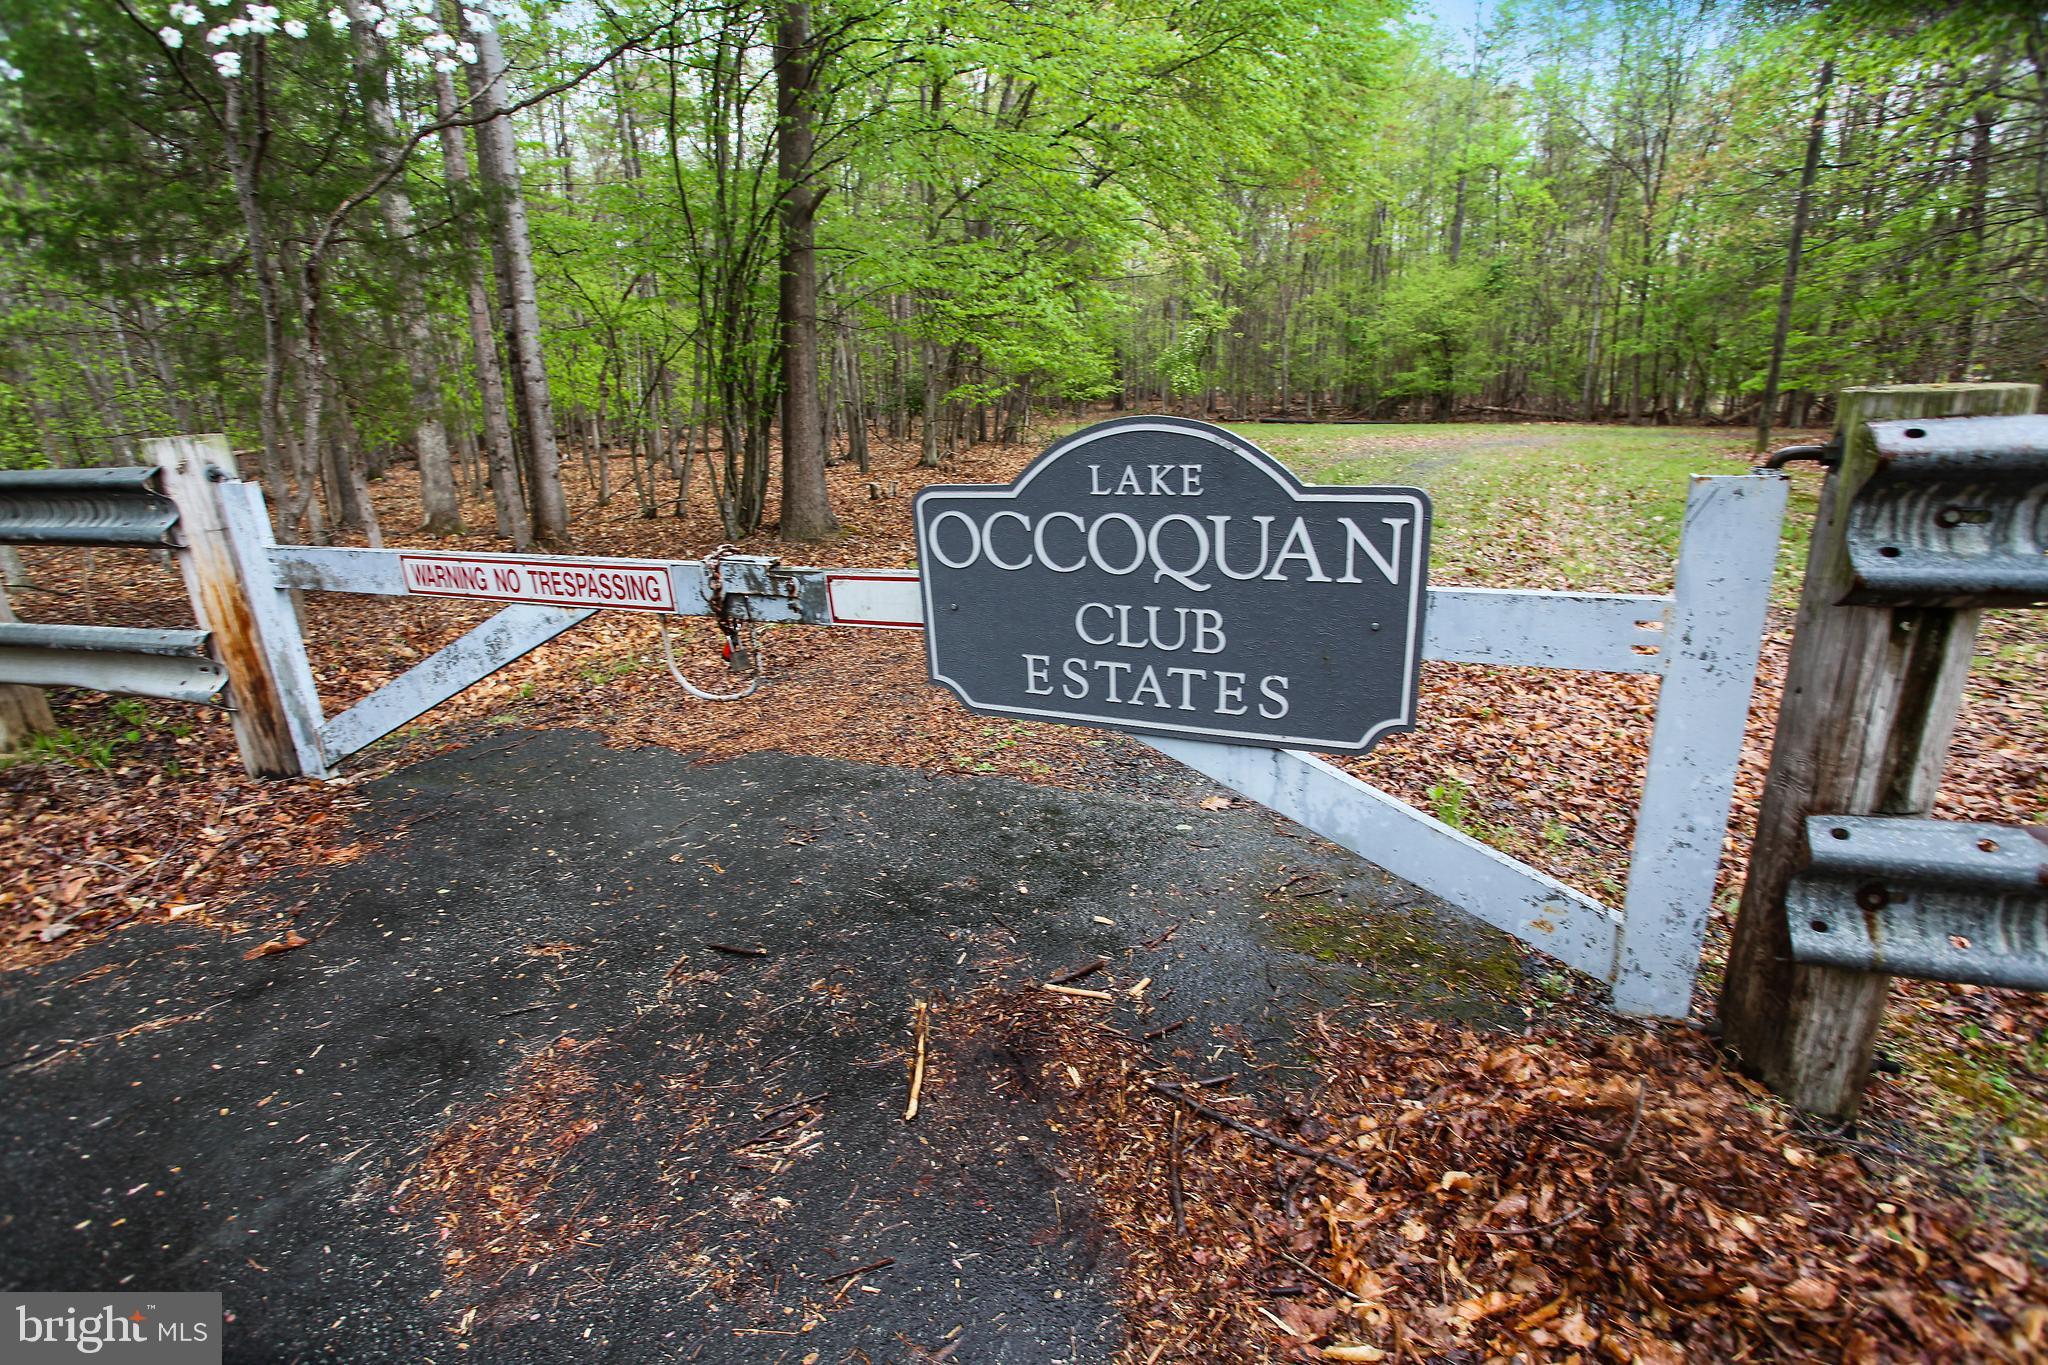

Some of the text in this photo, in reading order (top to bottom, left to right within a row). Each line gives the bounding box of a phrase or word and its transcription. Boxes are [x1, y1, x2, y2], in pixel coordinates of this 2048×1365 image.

[1088, 464, 1204, 496] LAKE
[928, 510, 1409, 591] OCCOQUAN
[412, 563, 662, 602] WARNING NO TRESPASSING
[1075, 602, 1227, 654] CLUB
[1022, 654, 1289, 720] ESTATES
